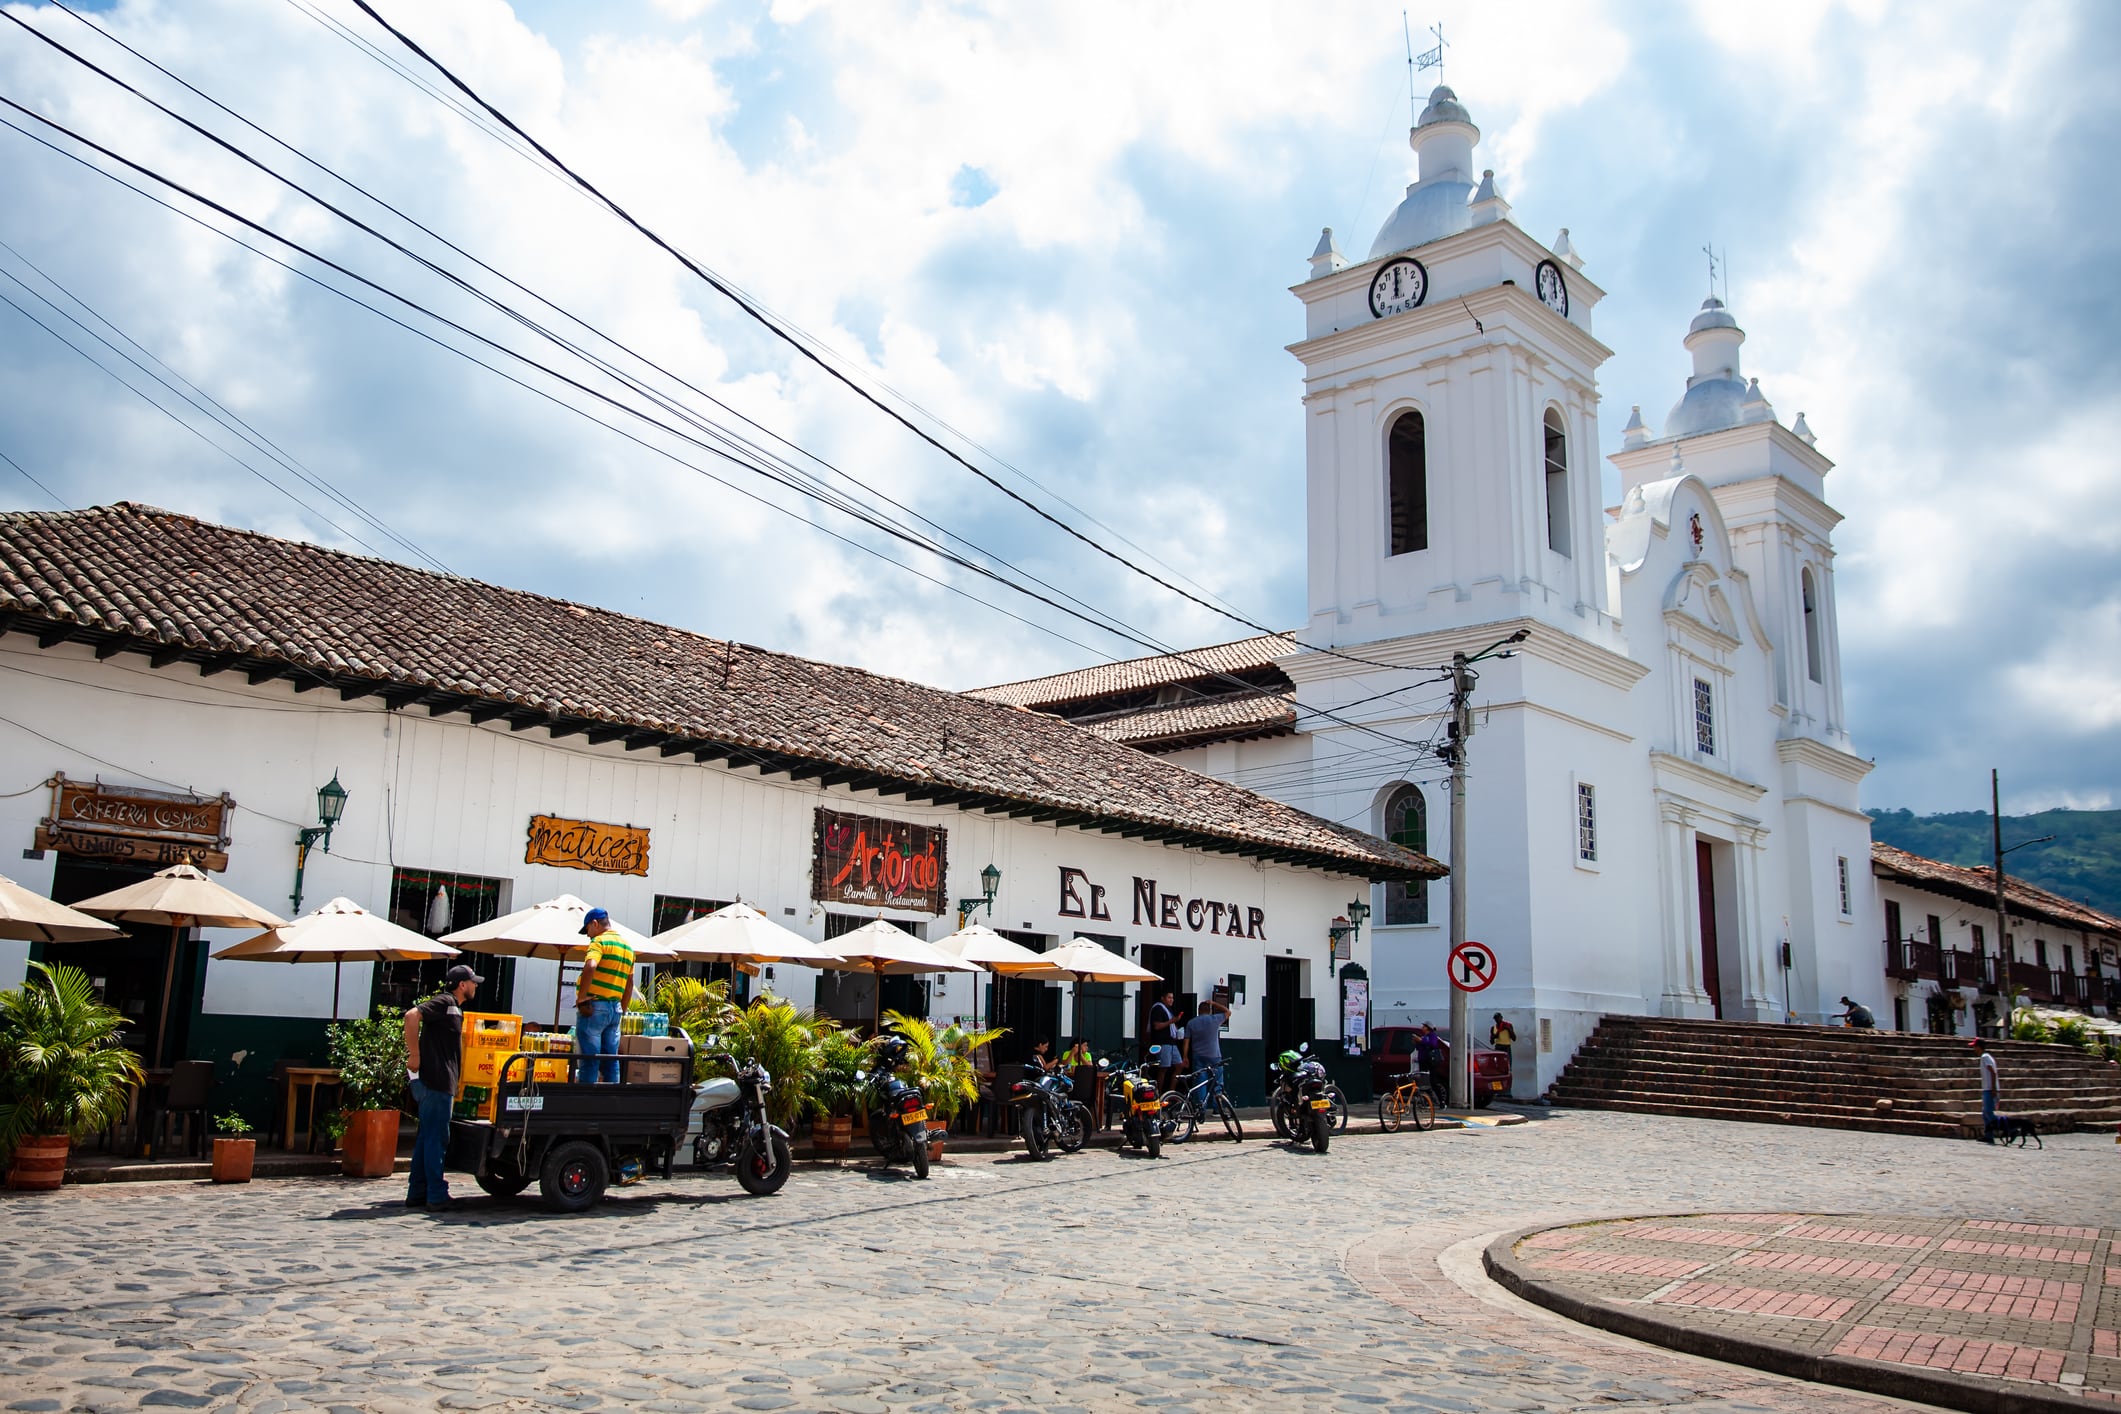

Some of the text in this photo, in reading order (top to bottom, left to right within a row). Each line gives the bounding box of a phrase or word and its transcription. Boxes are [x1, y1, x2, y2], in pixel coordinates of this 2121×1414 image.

[1404, 267, 1408, 275] 1
[1410, 271, 1416, 279] 2
[1384, 272, 1390, 282] 11
[1378, 282, 1387, 291] 10
[1414, 280, 1420, 290] 3
[1376, 293, 1381, 302] 9
[1412, 291, 1416, 300] 4
[1380, 302, 1385, 310] 8
[1404, 299, 1410, 308] 5
[1387, 305, 1392, 314] 7
[1396, 305, 1401, 313] 6
[71, 795, 209, 829] CAFETERIA COSMOS
[825, 825, 851, 853] El
[592, 857, 602, 866] de
[843, 884, 928, 907] Parrilla Restaurante
[1058, 866, 1111, 921] EL
[1132, 876, 1267, 940] NECTAR
[1464, 952, 1485, 982] P
